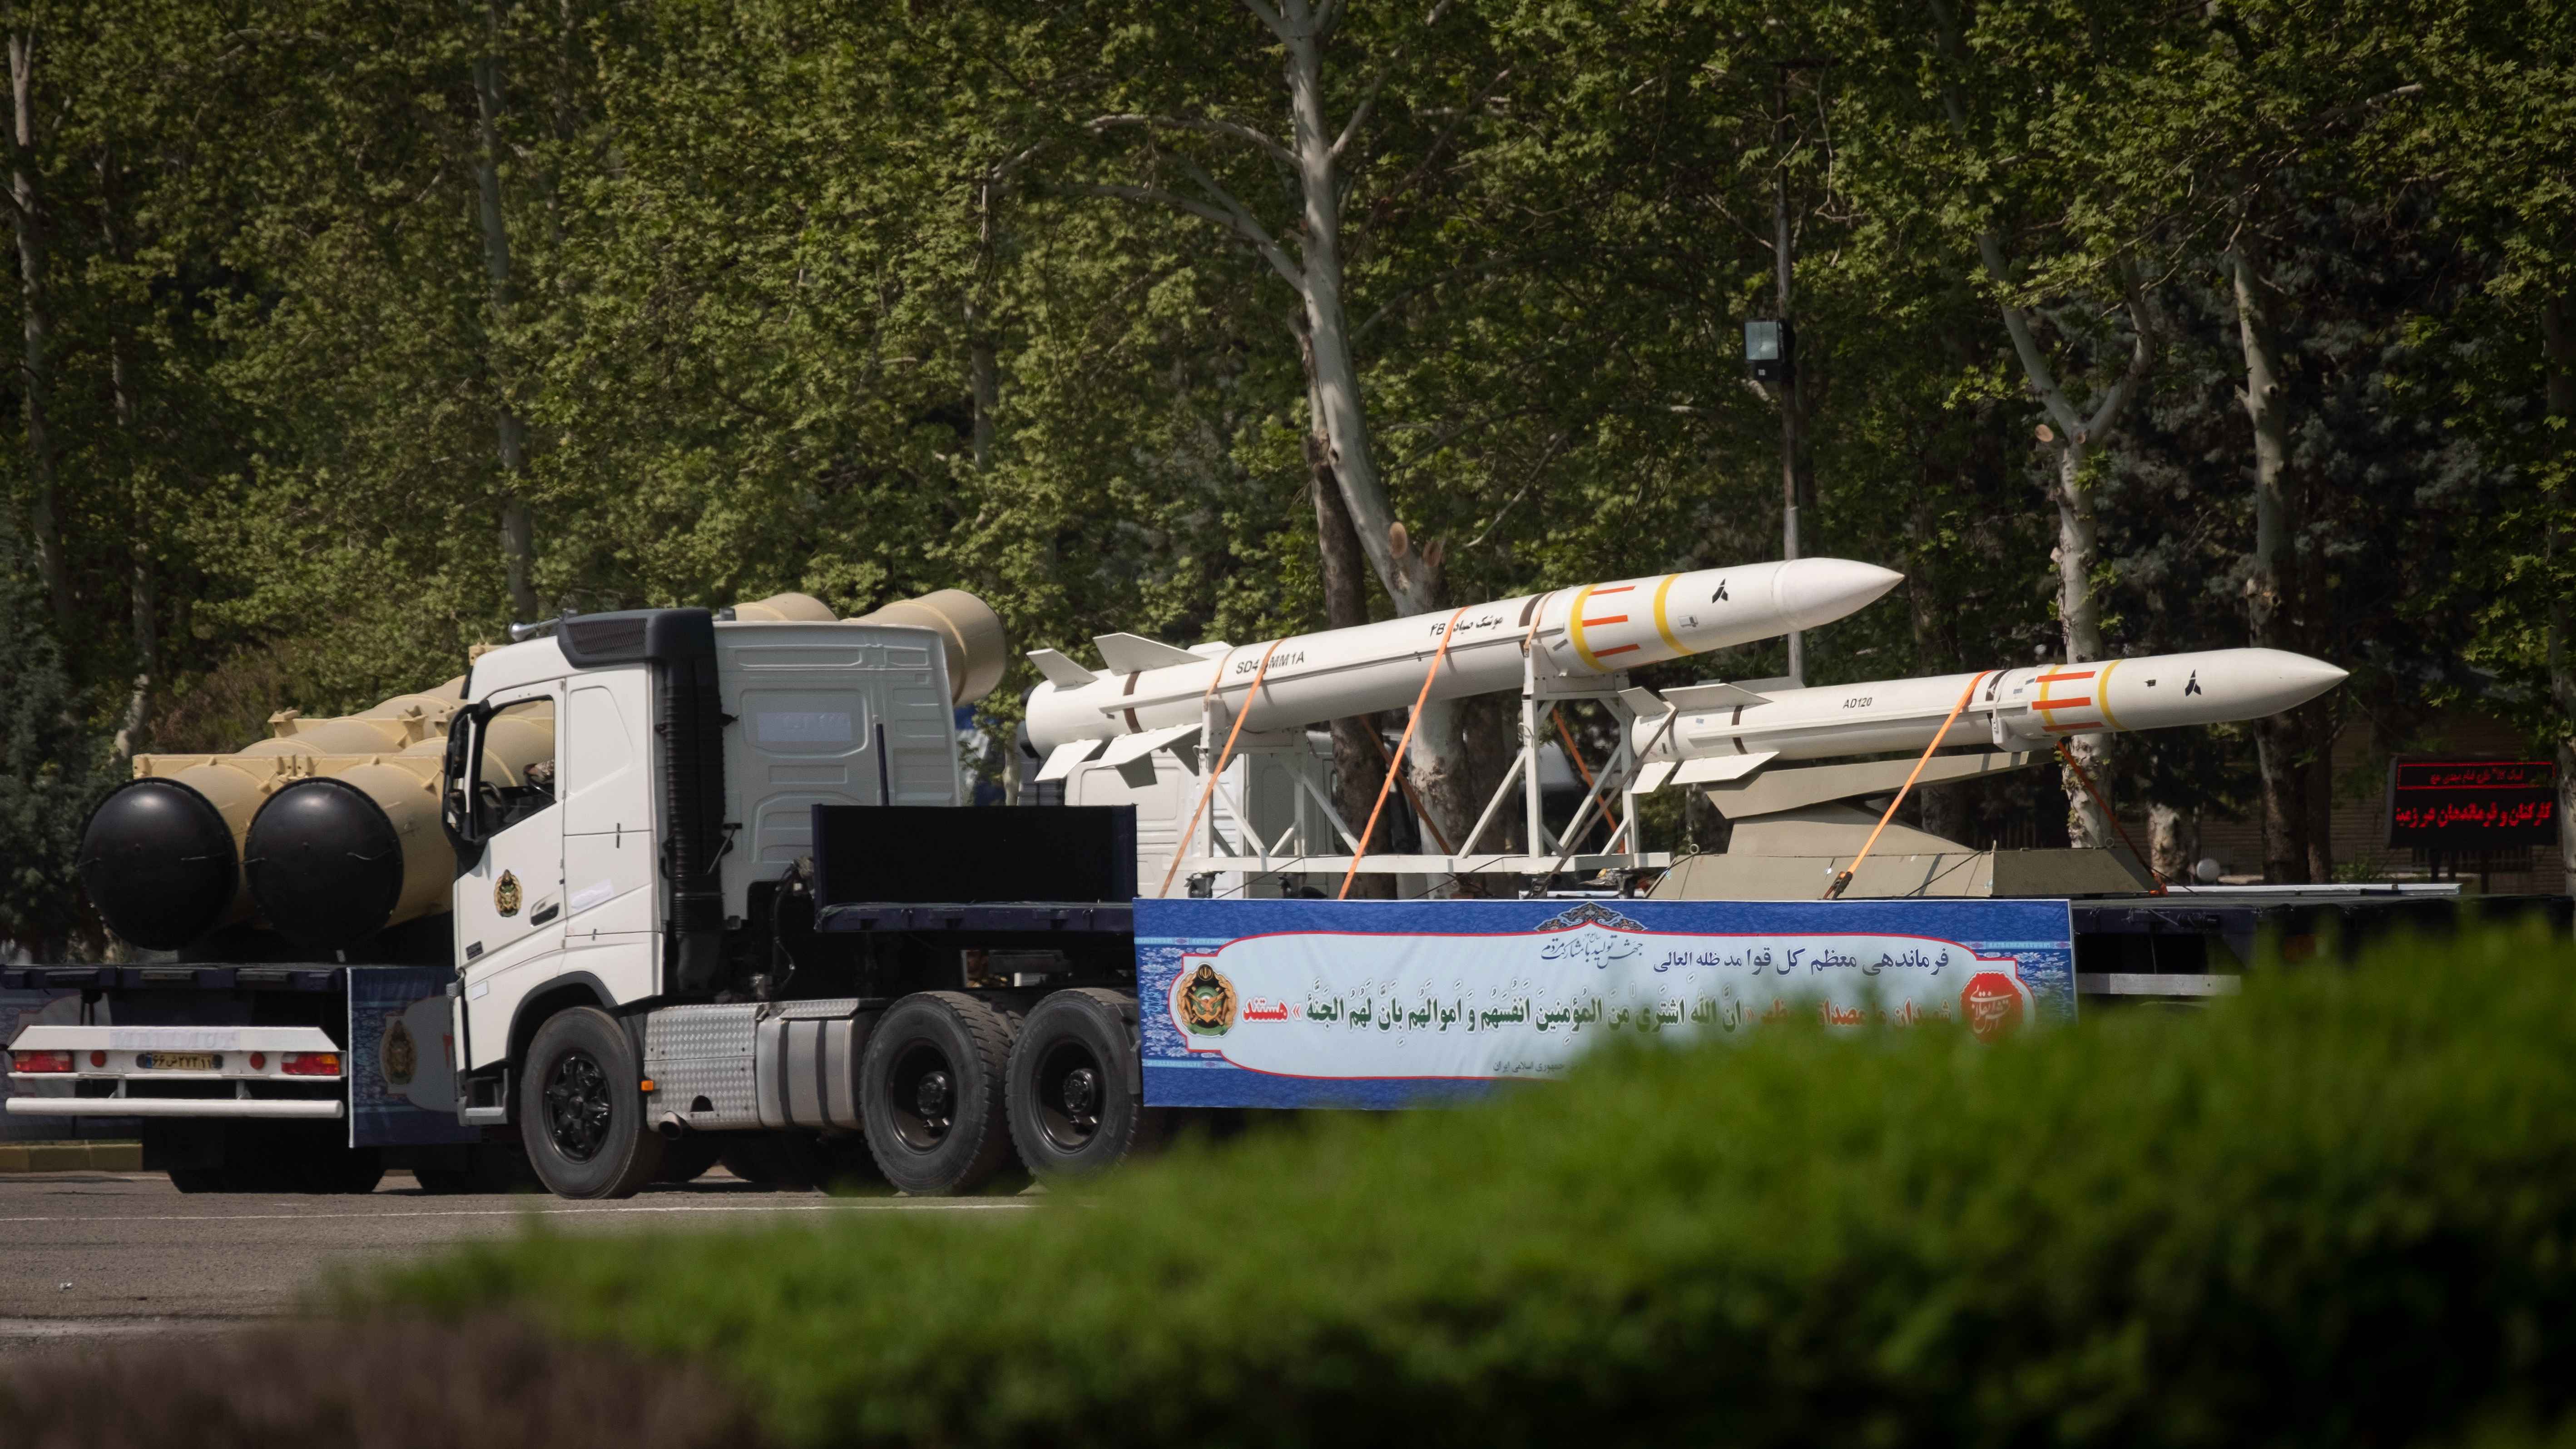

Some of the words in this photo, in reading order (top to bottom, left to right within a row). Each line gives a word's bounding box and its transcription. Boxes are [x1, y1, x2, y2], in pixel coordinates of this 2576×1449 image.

[1476, 614, 1503, 630] موشک
[1236, 650, 1305, 674] SD4MM1A
[1843, 697, 1873, 709] AD120
[1654, 951, 1692, 972] العالی
[1696, 951, 1720, 966] ظله
[1747, 948, 1771, 975] قوا
[1777, 948, 1806, 975] کل
[1810, 948, 1857, 975] معظم
[1862, 948, 1949, 976] فرماندهی
[1243, 1000, 1288, 1020] هستند
[1493, 1061, 1510, 1073] ایران
[1512, 1061, 1533, 1073] اسلامی
